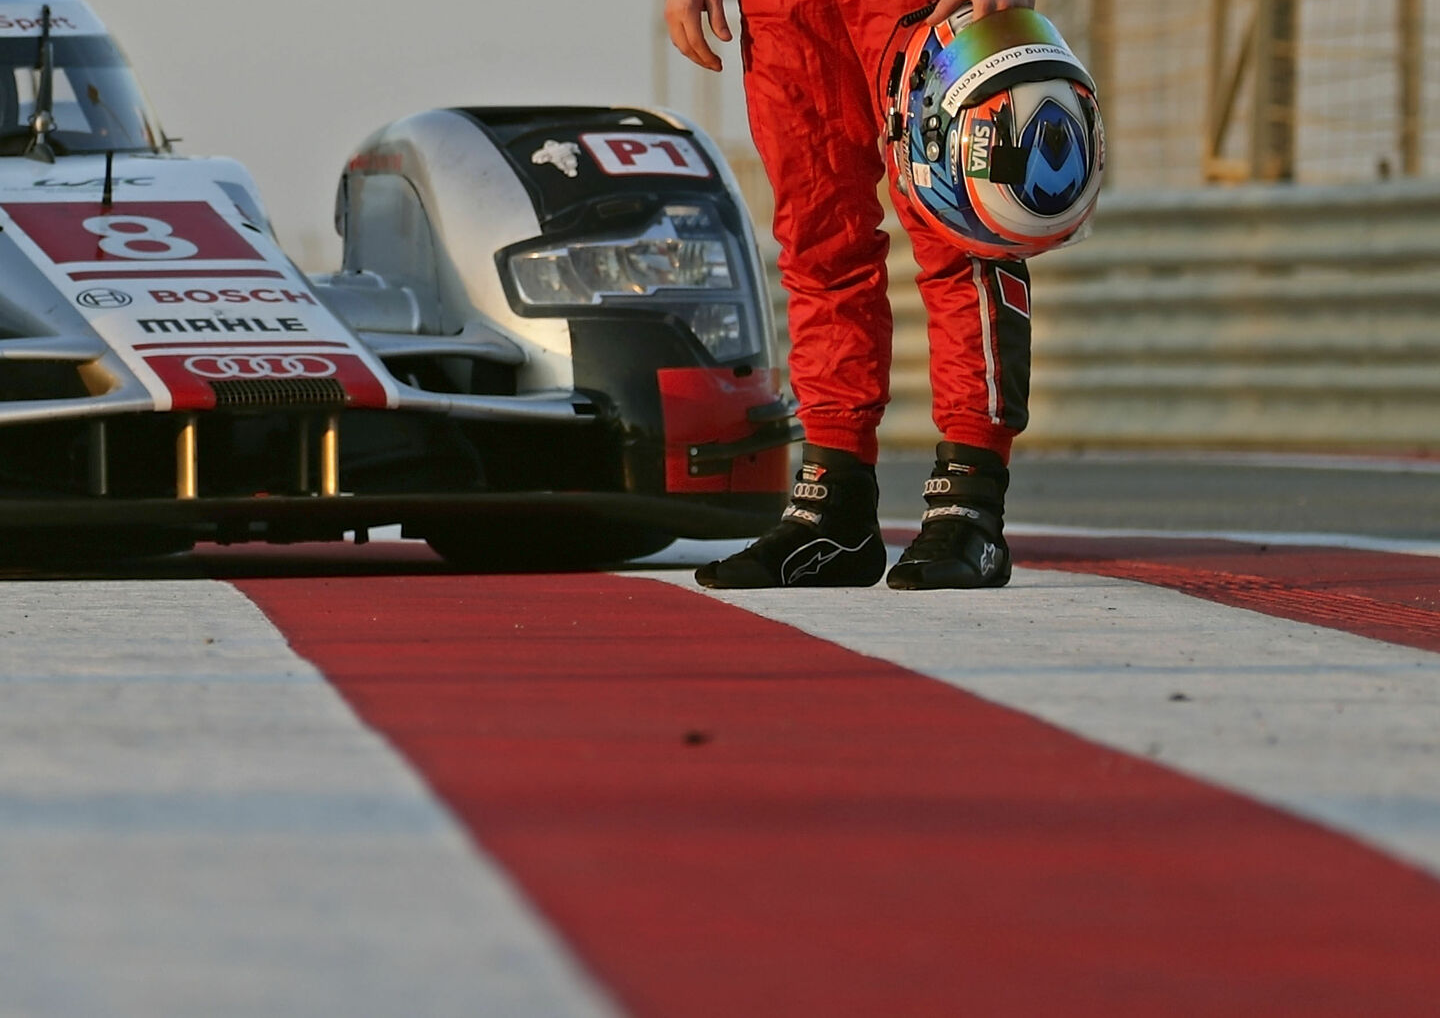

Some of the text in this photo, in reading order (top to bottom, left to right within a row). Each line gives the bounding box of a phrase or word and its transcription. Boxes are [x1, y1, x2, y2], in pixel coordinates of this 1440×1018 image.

[986, 51, 1022, 69] durch
[947, 67, 985, 108] Technik
[605, 138, 688, 168] P1
[971, 125, 990, 172] SMA
[82, 214, 199, 260] 8
[148, 289, 317, 305] BOSCH
[137, 317, 308, 333] MAHLE
